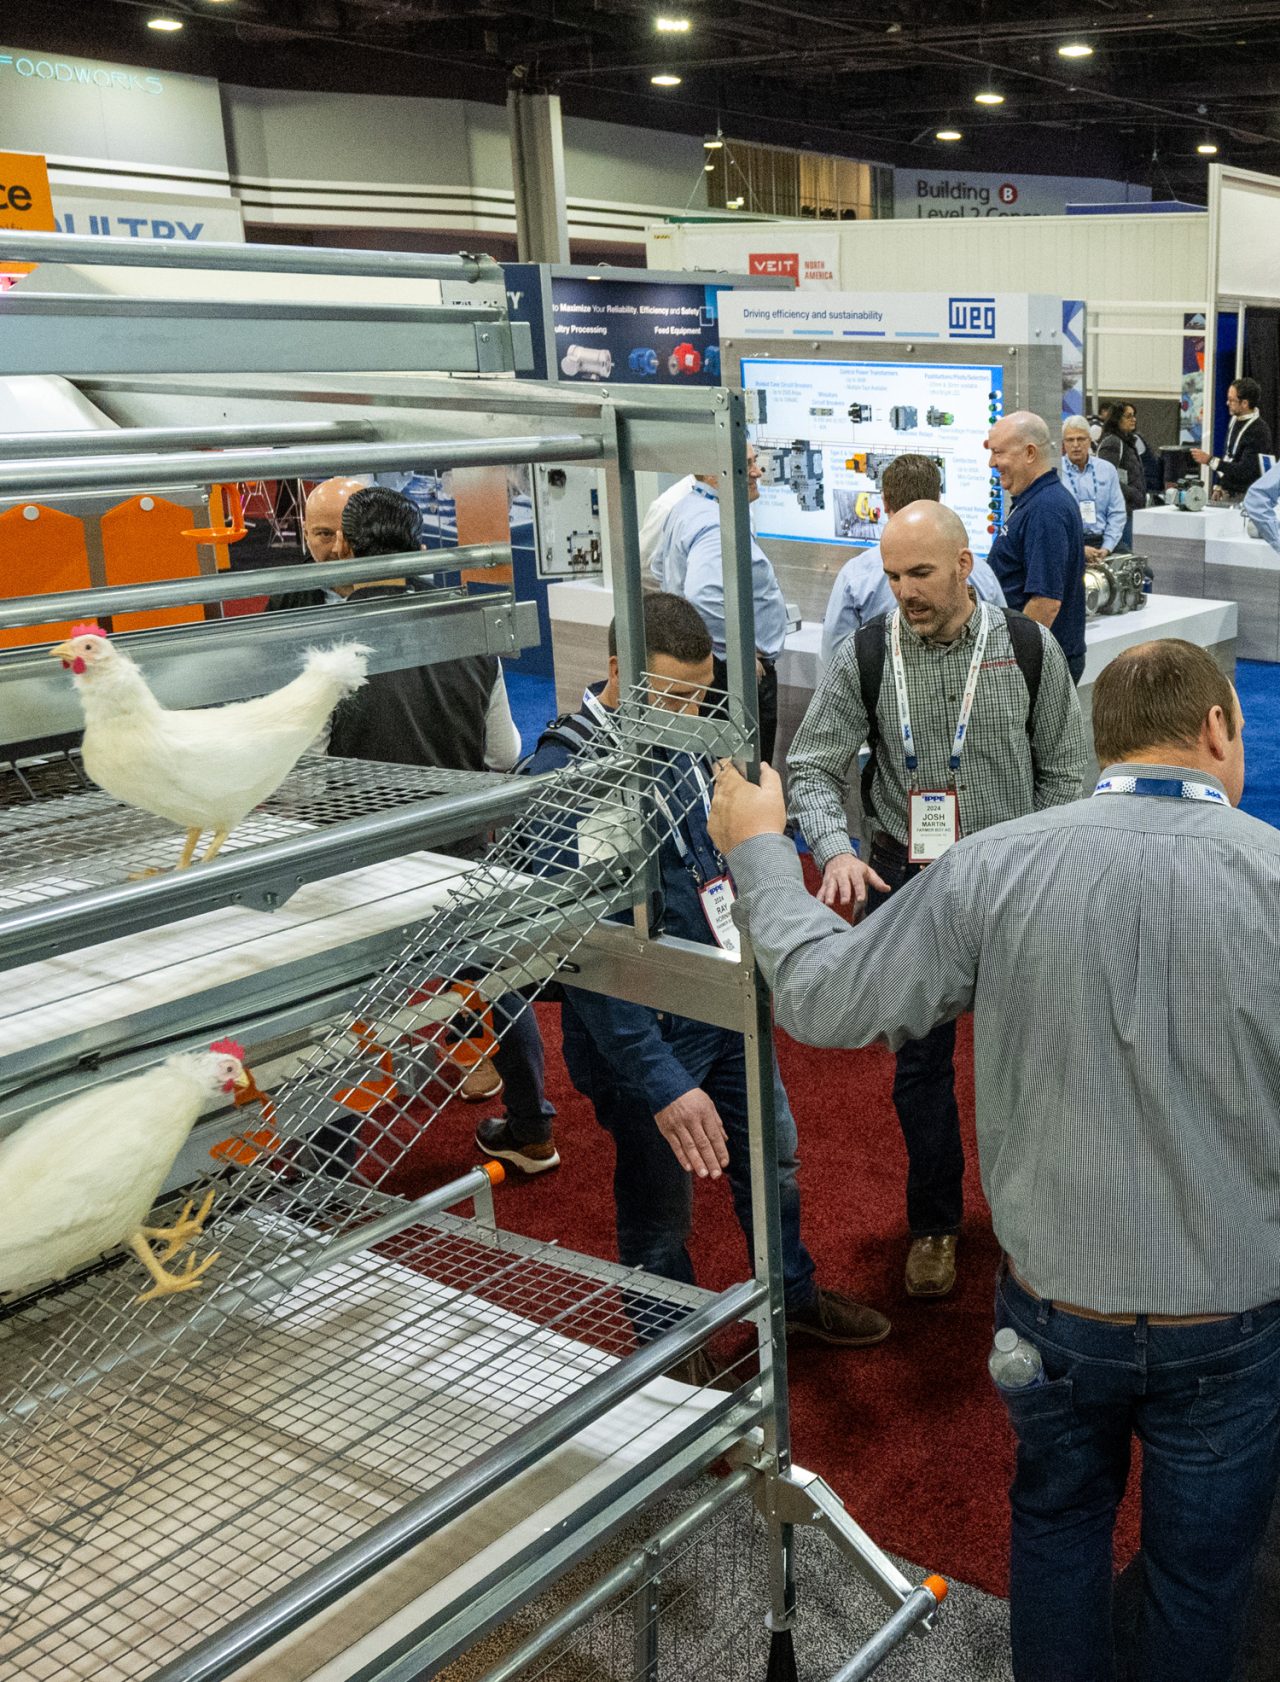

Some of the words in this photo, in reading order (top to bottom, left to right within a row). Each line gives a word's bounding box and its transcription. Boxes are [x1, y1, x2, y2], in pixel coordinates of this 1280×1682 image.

[917, 180, 990, 205] Building
[754, 260, 794, 272] VEIT
[804, 261, 825, 270] NORTH
[804, 271, 833, 281] AMERICA
[560, 304, 591, 313] Maximize
[592, 304, 606, 313] Your
[640, 306, 669, 316] Efficiency
[670, 307, 681, 315] and
[681, 307, 700, 317] Safety
[744, 309, 771, 320] Driving
[771, 309, 810, 320] efficiency
[811, 310, 827, 319] and
[828, 310, 883, 322] sustainability
[571, 325, 607, 335] Processing
[654, 326, 670, 335] Feed
[670, 326, 701, 336] Equipment
[922, 813, 945, 821] JOSH
[716, 903, 728, 914] RAY
